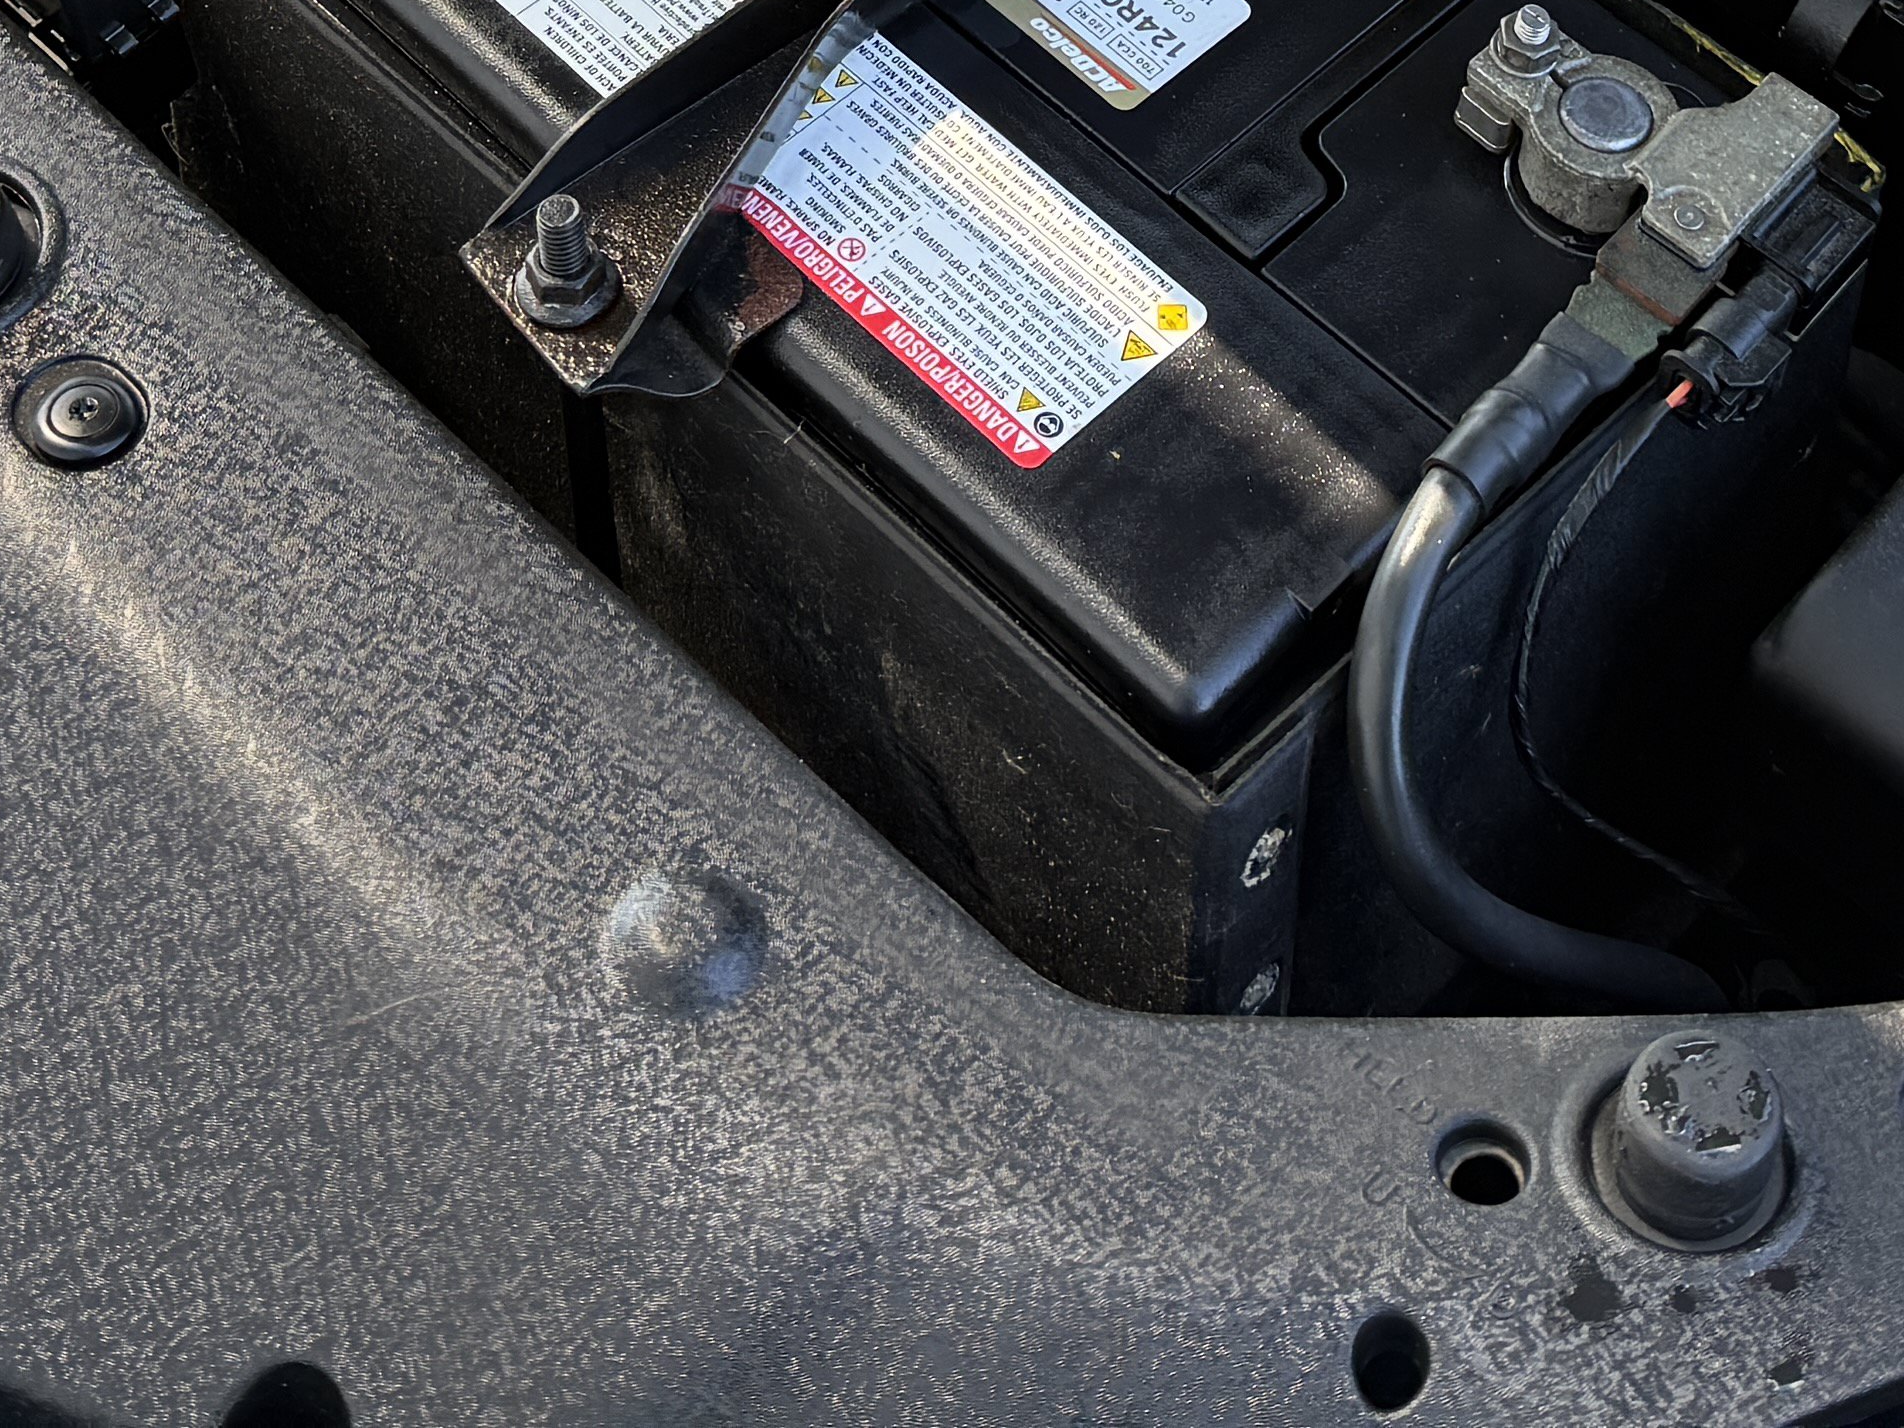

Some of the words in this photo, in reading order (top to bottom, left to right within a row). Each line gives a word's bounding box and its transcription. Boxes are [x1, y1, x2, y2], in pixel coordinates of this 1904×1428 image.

[1073, 5, 1090, 20] RC
[577, 17, 599, 36] LOS
[593, 31, 611, 47] DE
[628, 20, 645, 34] LA
[640, 30, 671, 57] UVRIR
[870, 37, 894, 59] CON
[1030, 16, 1127, 93] ACDelco
[1114, 39, 1138, 59] CCA
[582, 61, 599, 76] OF
[889, 52, 926, 86] RAPIDO
[1133, 55, 1156, 74] 700
[893, 75, 913, 93] UN
[922, 79, 957, 112] ACUDA
[892, 92, 919, 118] HELP
[982, 131, 1007, 153] CON
[797, 146, 830, 176] FUMER
[912, 156, 933, 176] DES
[755, 173, 787, 203] FLAME
[824, 170, 842, 186] DE
[927, 170, 945, 186] OU
[876, 172, 921, 213] CIGARROS
[916, 180, 949, 210] SEVERE
[803, 194, 847, 235] SMOKING
[888, 204, 909, 223] NO
[943, 204, 961, 220] OR
[965, 203, 982, 218] LA
[813, 226, 836, 247] NO
[857, 220, 883, 244] PAS
[877, 216, 896, 234] DE
[976, 211, 1012, 244] CAUSER
[1083, 215, 1112, 241] OJOS
[911, 223, 970, 278] EXPLOSIVOS
[1007, 237, 1034, 262] PEUT
[1107, 236, 1131, 257] LOS
[887, 247, 940, 295] EXPLOSIFS
[994, 248, 1026, 277] CAUSE
[1126, 251, 1174, 295] ENJUAGE
[866, 274, 902, 306] GASES
[878, 265, 913, 296] INJURY.
[965, 271, 1001, 304] GASES
[1020, 271, 1044, 292] CAN
[1027, 254, 1087, 309] SULFURIQUE
[909, 292, 926, 307] OR
[934, 288, 959, 311] GAZ
[995, 297, 1020, 320] LOS
[1038, 286, 1067, 312] ACID
[896, 299, 951, 349] EXPLOSIVE
[923, 302, 973, 349] BLINDNESS
[953, 305, 977, 326] LES
[972, 299, 1010, 334] RENDRE
[1018, 297, 1055, 330] DAÑOS
[1082, 302, 1122, 338] L'ACIDE
[1003, 327, 1022, 344] OU
[1049, 322, 1088, 358] CAUSAR
[1060, 305, 1109, 349] SULFURIC
[944, 342, 976, 371] EYES.
[967, 343, 1000, 372] CAUSE
[998, 344, 1021, 366] LES
[1016, 339, 1058, 376] BLESSER
[1042, 338, 1068, 361] LOS
[880, 315, 1021, 443] DANGER/POISON
[997, 369, 1021, 390] CAN
[1061, 354, 1110, 398] PROTEJA
[1083, 352, 1122, 387] PUEDEN
[971, 366, 1010, 401] SHIELD
[1014, 360, 1070, 410] PROTÉGER
[1052, 370, 1096, 410] PEUVENT
[1062, 401, 1083, 420] SE
